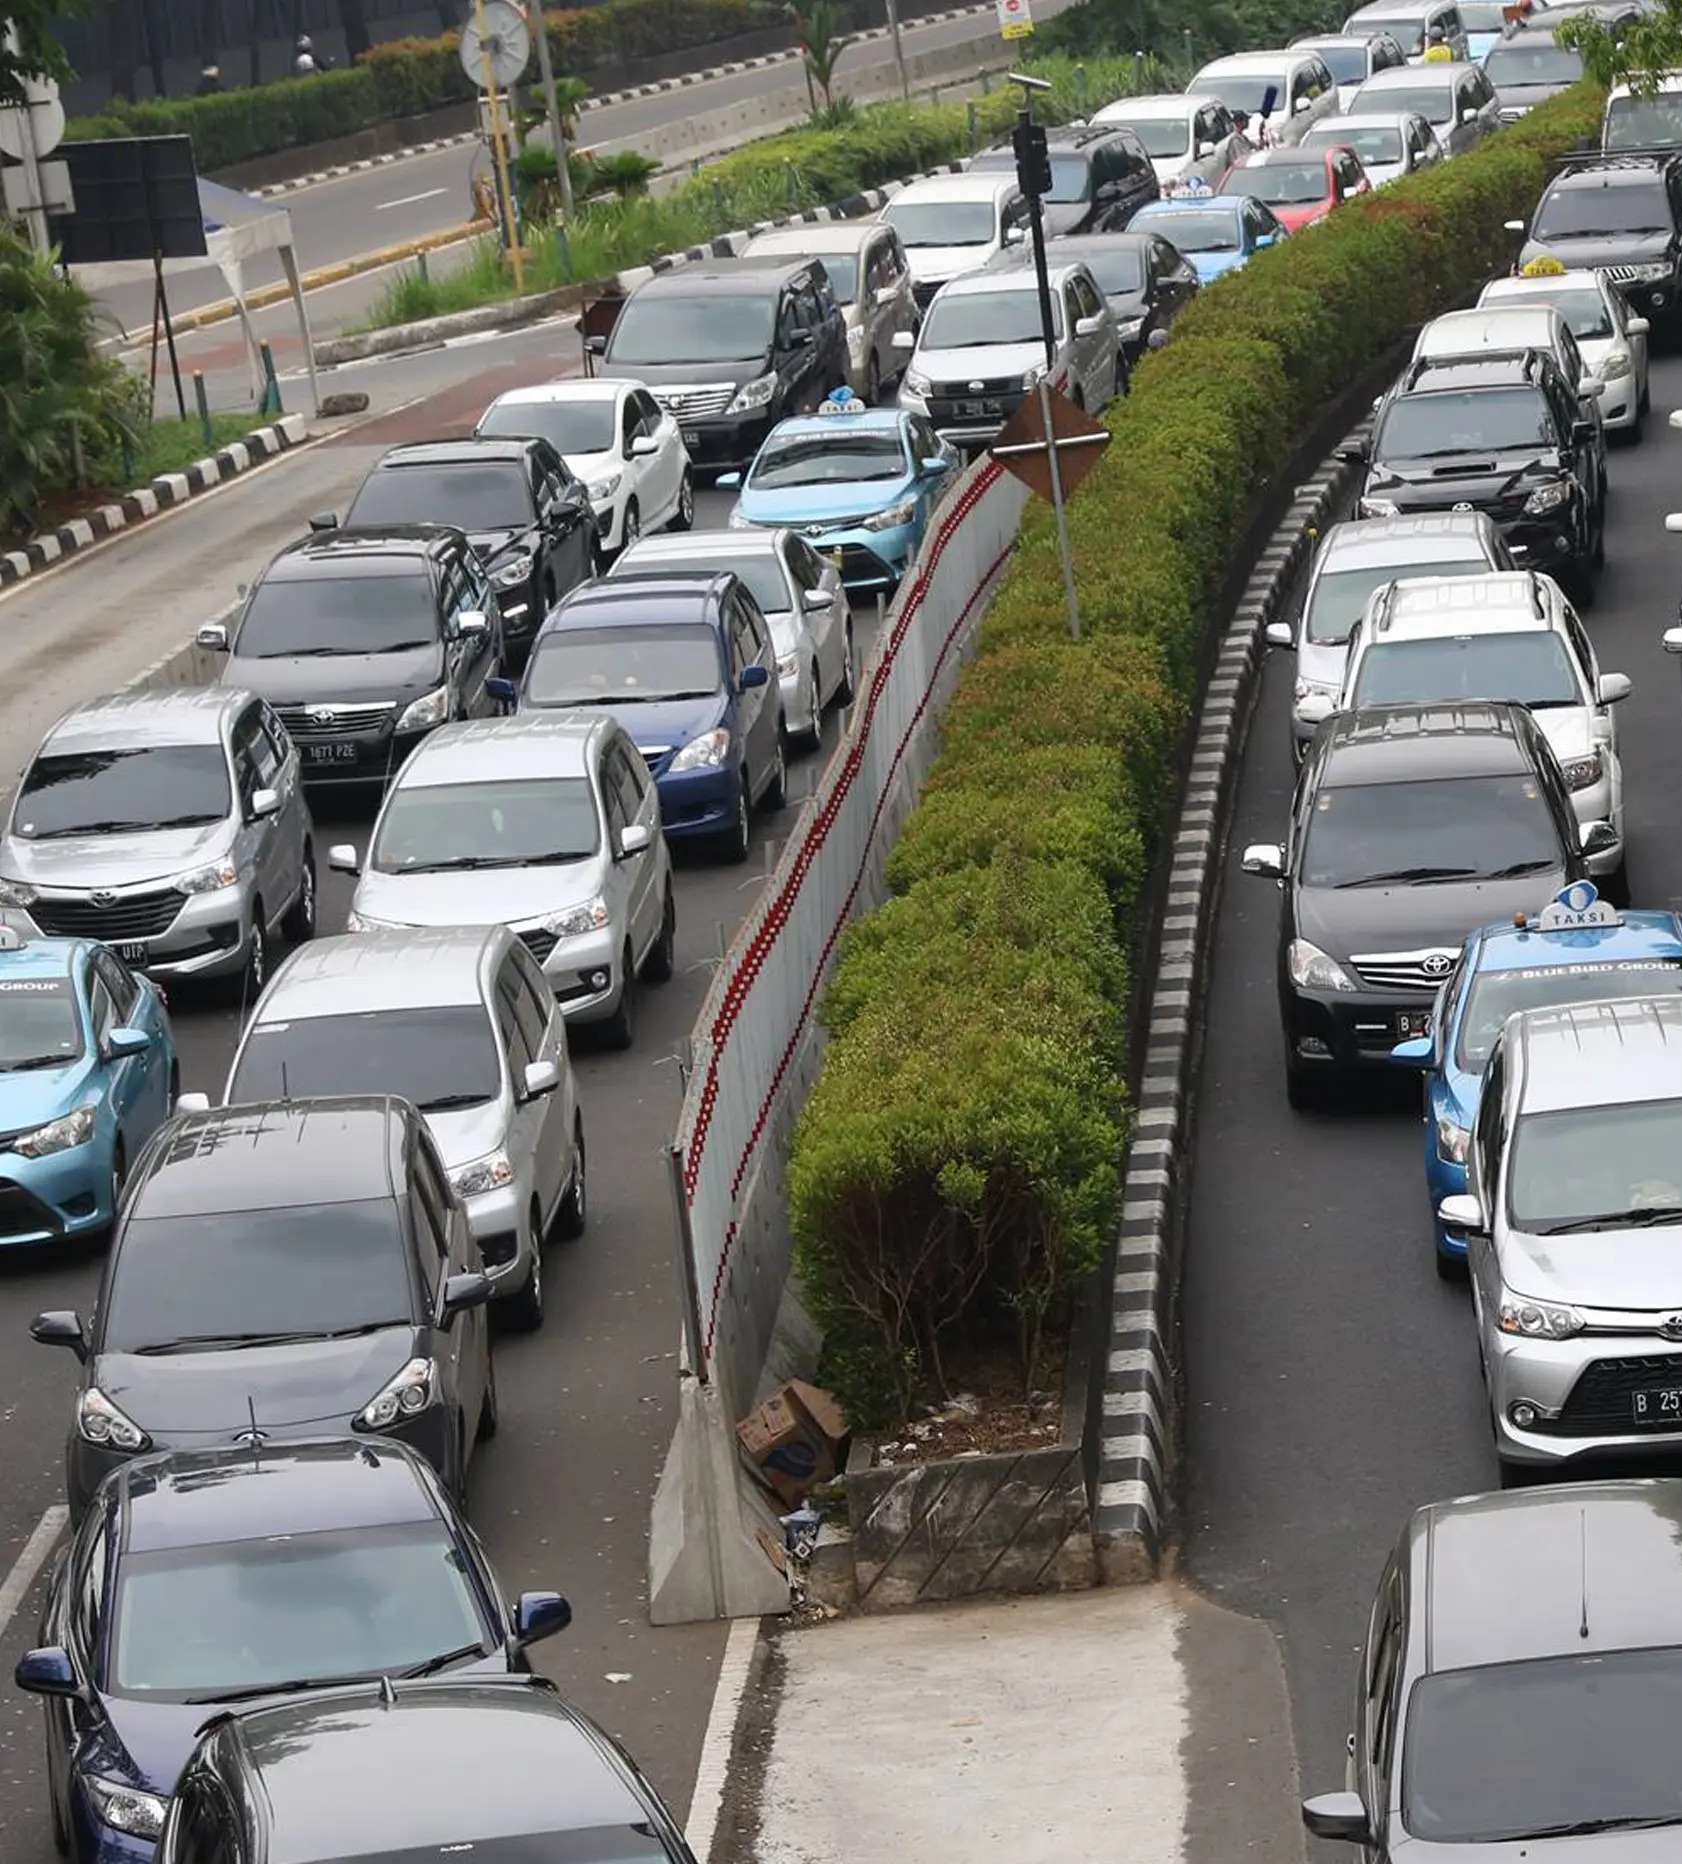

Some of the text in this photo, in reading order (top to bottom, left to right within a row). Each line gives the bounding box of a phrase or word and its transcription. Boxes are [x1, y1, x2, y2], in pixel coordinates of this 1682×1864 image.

[1552, 911, 1606, 926] TAKSI
[1400, 1016, 1409, 1031] B
[1636, 1394, 1647, 1412] B
